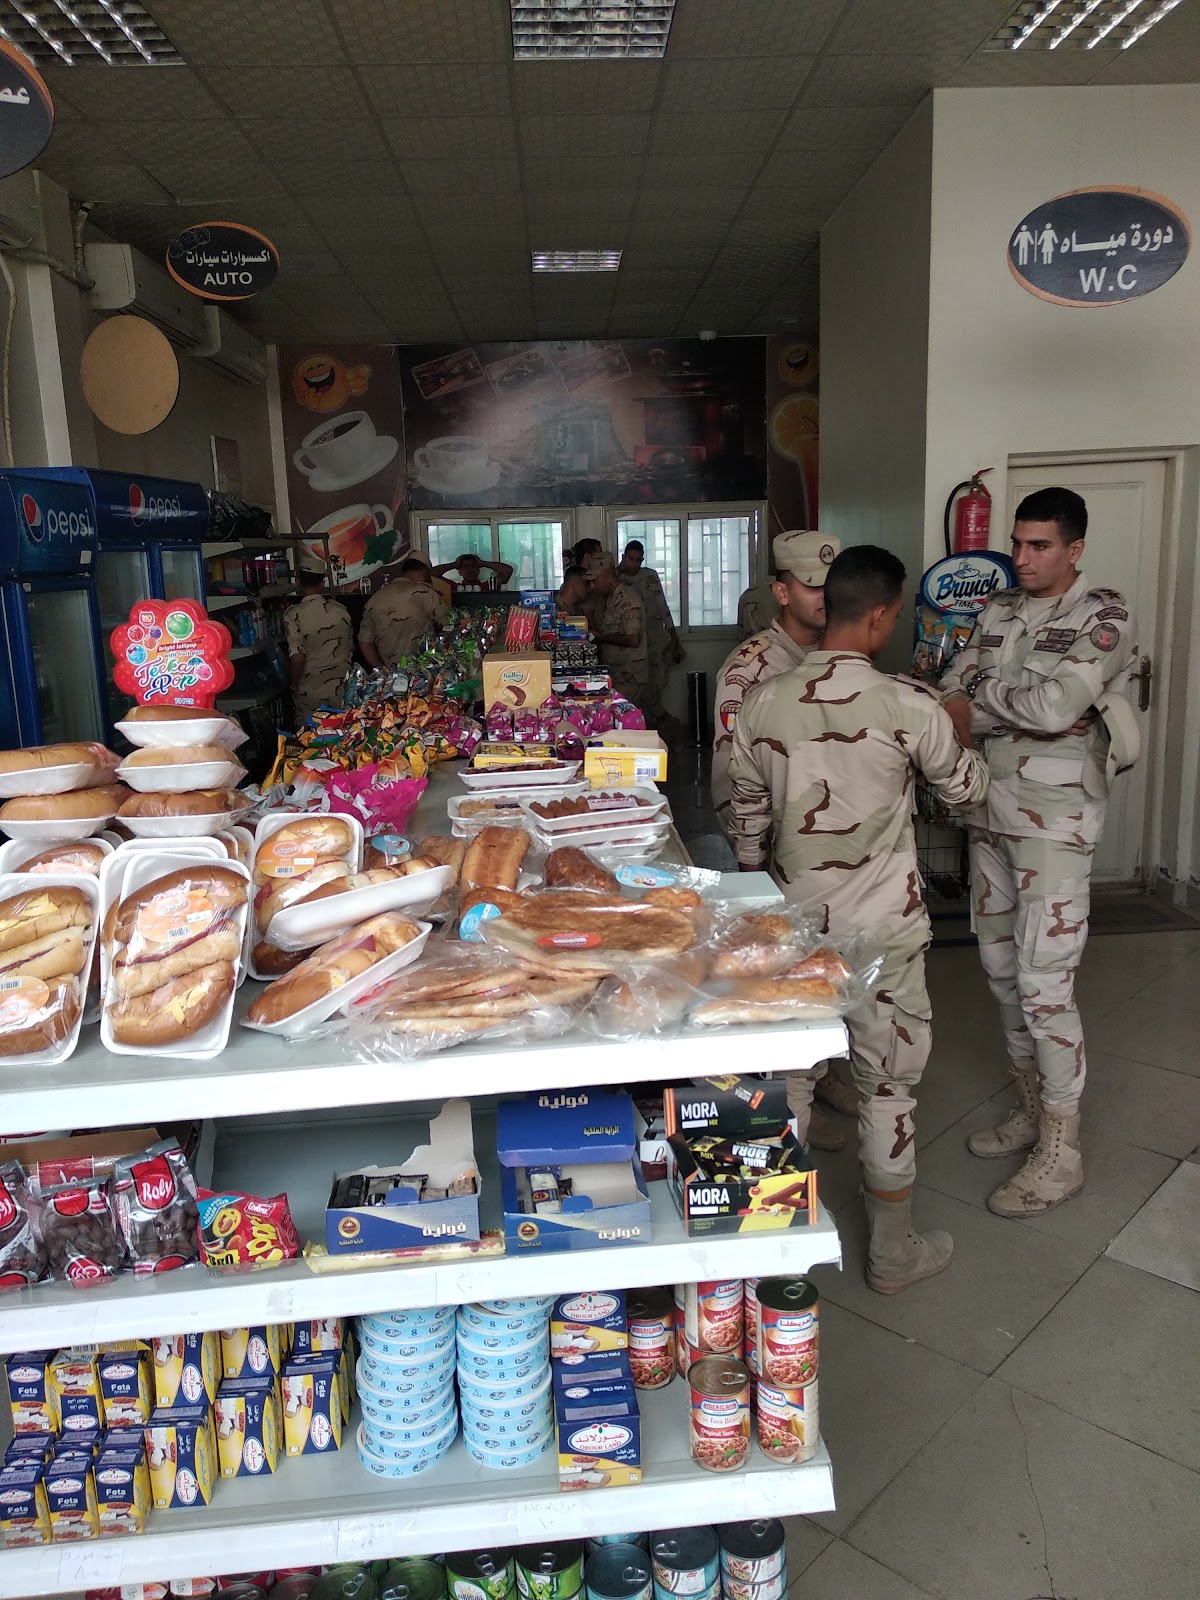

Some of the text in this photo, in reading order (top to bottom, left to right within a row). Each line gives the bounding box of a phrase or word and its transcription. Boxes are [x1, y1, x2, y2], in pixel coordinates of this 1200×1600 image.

[1060, 223, 1174, 257] دورة مياه
[186, 250, 271, 267] اكسسوارات سيارات
[203, 271, 253, 286] AUTO
[1079, 264, 1137, 294] W.C
[149, 494, 181, 523] pepsi
[47, 507, 91, 543] pepsi
[936, 569, 999, 601] Brunch
[954, 599, 977, 609] TIME
[538, 1093, 589, 1109] فولية
[681, 1101, 719, 1120] MORA
[731, 1144, 769, 1160] MORA
[142, 1177, 172, 1202] Roly
[689, 1188, 731, 1205] MORA
[247, 1201, 271, 1215] Lorenz
[422, 1221, 467, 1238] فولية
[597, 1226, 641, 1240] فولية
[489, 1320, 496, 1328] 8
[631, 1325, 663, 1333] AMERICANA
[411, 1328, 417, 1336] 8
[18, 1387, 38, 1395] Feta
[110, 1384, 131, 1392] Feta
[318, 1380, 326, 1398] Feta
[515, 1387, 522, 1395] 8
[703, 1402, 737, 1411] AMERICANA
[105, 1488, 127, 1496] Feta
[57, 1497, 79, 1505] Feta
[7, 1506, 29, 1514] Feta
